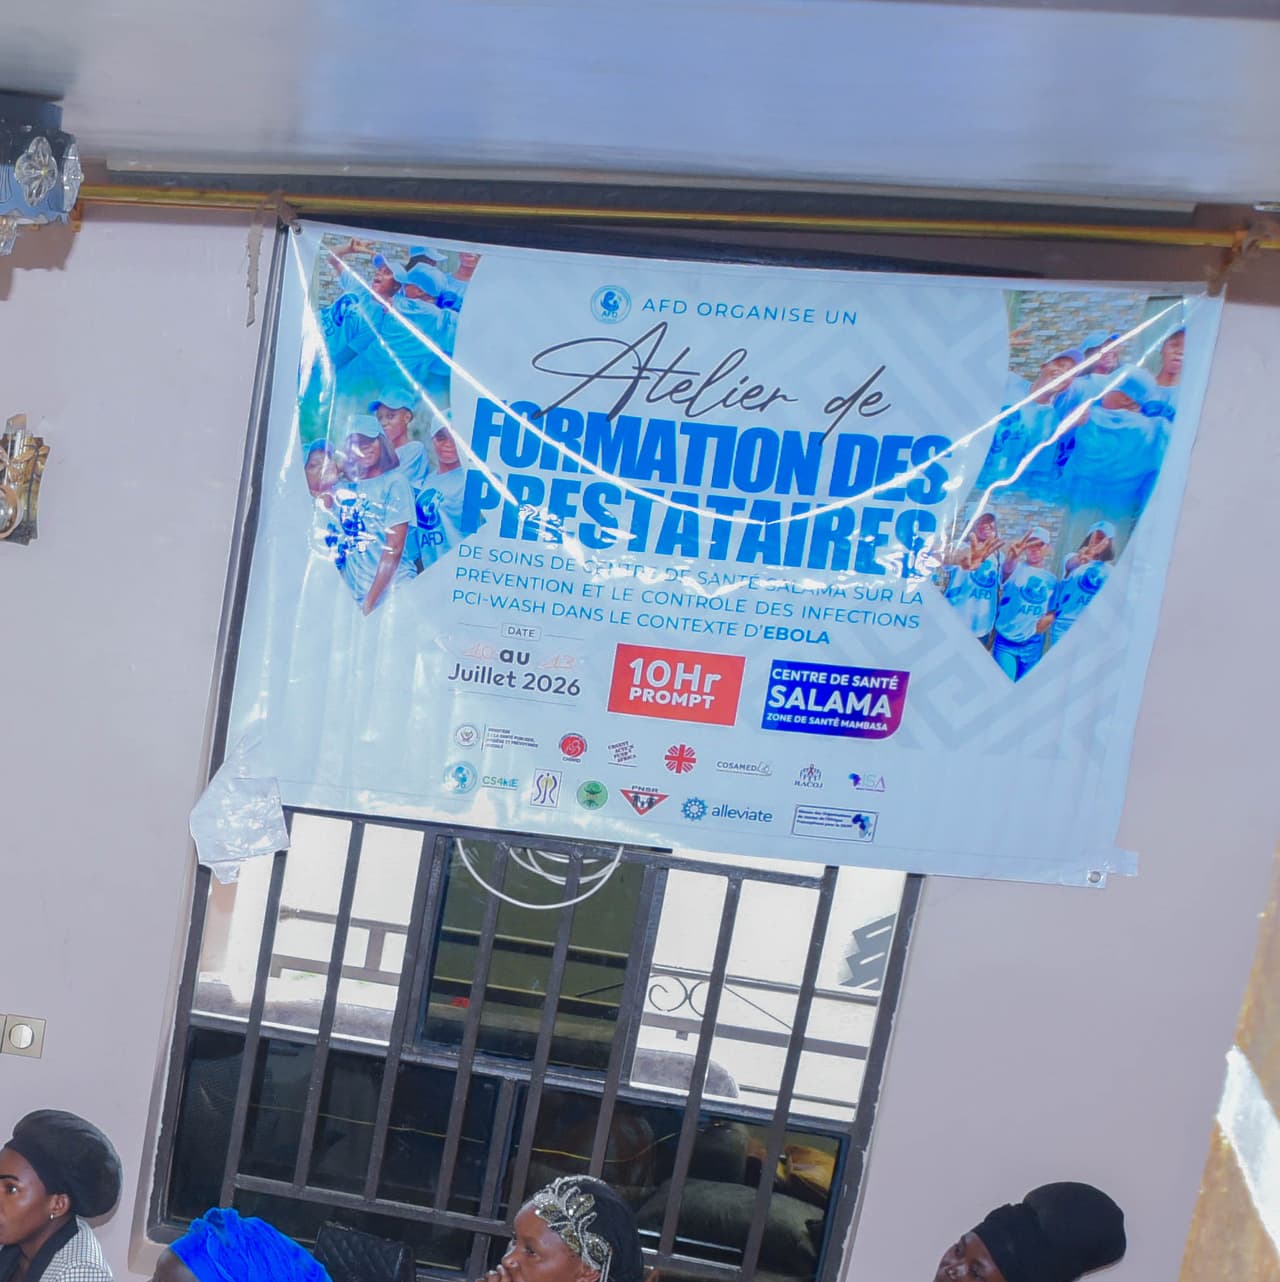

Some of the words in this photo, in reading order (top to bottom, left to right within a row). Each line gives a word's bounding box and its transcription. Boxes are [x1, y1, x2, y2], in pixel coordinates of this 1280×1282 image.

[642, 298, 688, 315] AFD
[697, 302, 816, 325] ORGANISE
[826, 310, 858, 325] UN
[532, 321, 799, 421] Atelier
[819, 365, 891, 446] de
[470, 397, 825, 495] FORMATION
[828, 432, 953, 505] DES
[461, 470, 937, 579] PRESTATAIRES
[458, 544, 482, 559] DE
[489, 550, 544, 568] SOINS
[551, 556, 576, 572] DE
[853, 586, 890, 601] SUR
[900, 592, 923, 604] LA
[453, 590, 545, 613] PCI-WASH
[552, 603, 604, 622] DANS
[610, 611, 631, 624] LE
[637, 613, 737, 636] CONTEXTE
[456, 566, 574, 595] PRÉVENTION
[582, 584, 604, 597] ET
[612, 587, 634, 601] LE
[755, 601, 793, 617] DES
[802, 606, 920, 629] INFECTIONS
[508, 626, 535, 638] DATE
[500, 649, 530, 665] au
[448, 663, 516, 688] Juillet
[522, 673, 580, 696] 2026
[629, 657, 722, 694] 10Hr
[772, 668, 827, 685] CENTRE
[830, 674, 849, 686] DE
[852, 675, 899, 690] SANTÉ
[629, 687, 715, 709] PROMPT
[768, 685, 891, 718] SALAMA
[767, 712, 792, 722] ZONE
[794, 715, 807, 724] DE
[808, 715, 840, 728] SANTÉ
[840, 718, 888, 731] MAMBASA
[716, 761, 756, 773] COSAMED
[711, 804, 773, 823] alleviate
